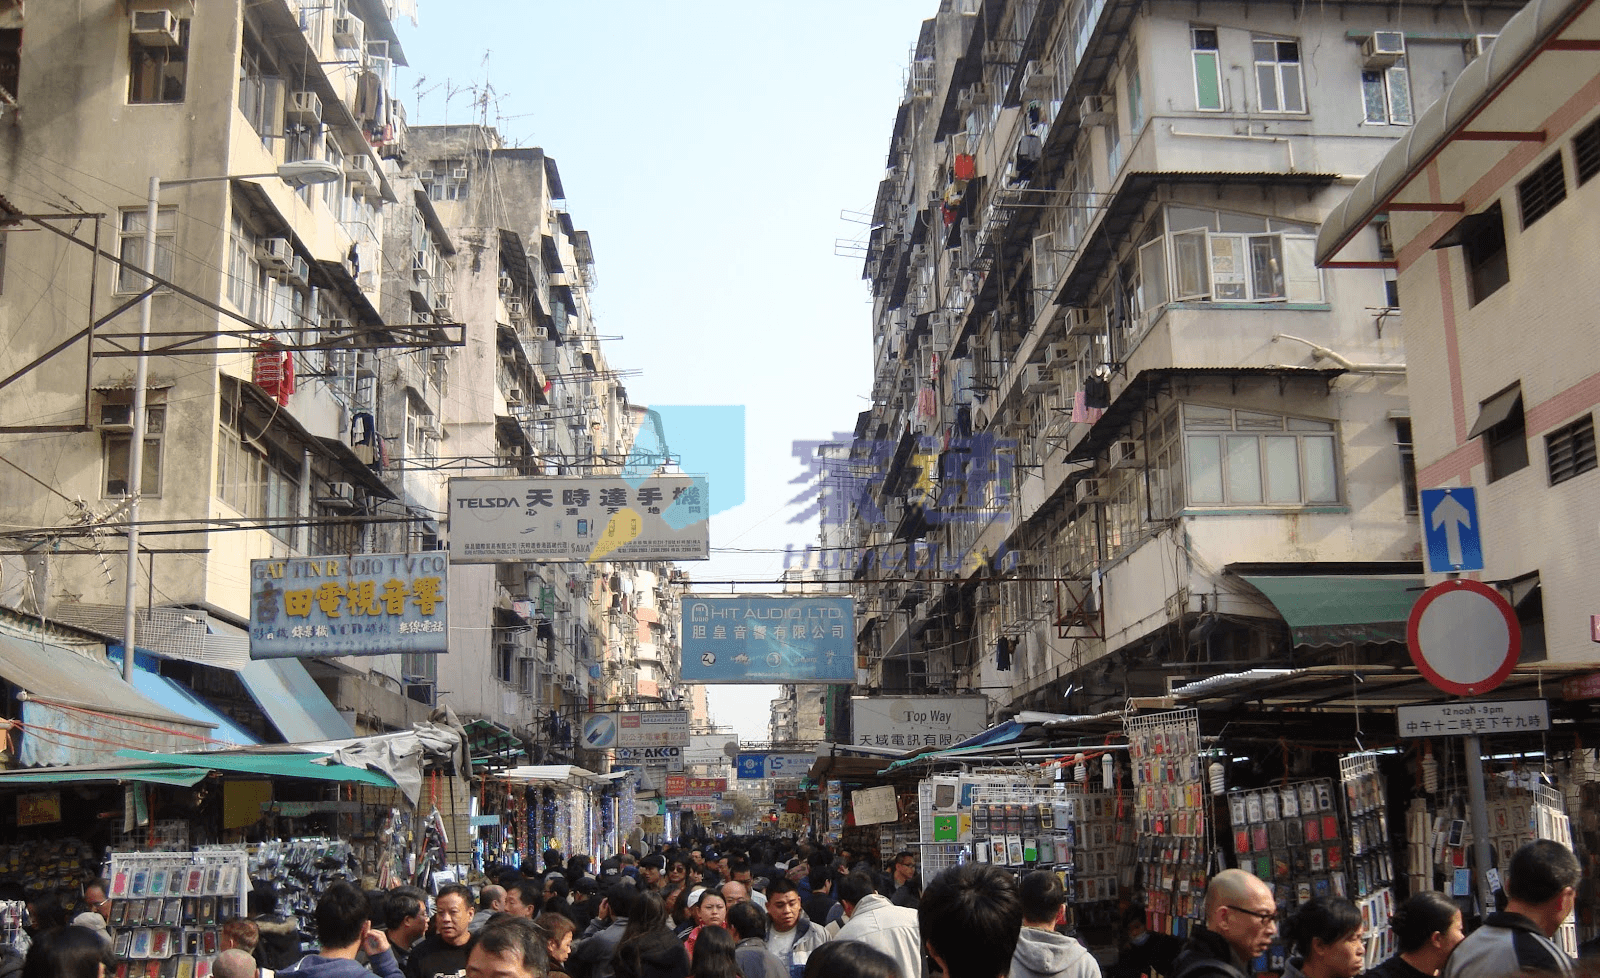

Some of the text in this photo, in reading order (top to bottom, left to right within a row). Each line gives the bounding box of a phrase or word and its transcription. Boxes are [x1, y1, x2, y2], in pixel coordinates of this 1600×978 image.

[456, 498, 520, 509] TELSDA
[526, 486, 701, 508] 天時達手機
[743, 607, 802, 619] AUDIO
[808, 607, 844, 619] LTD.
[903, 709, 952, 724] Top Way
[1442, 708, 1451, 716] 12
[1406, 715, 1541, 733] 中午十二時至下午九時
